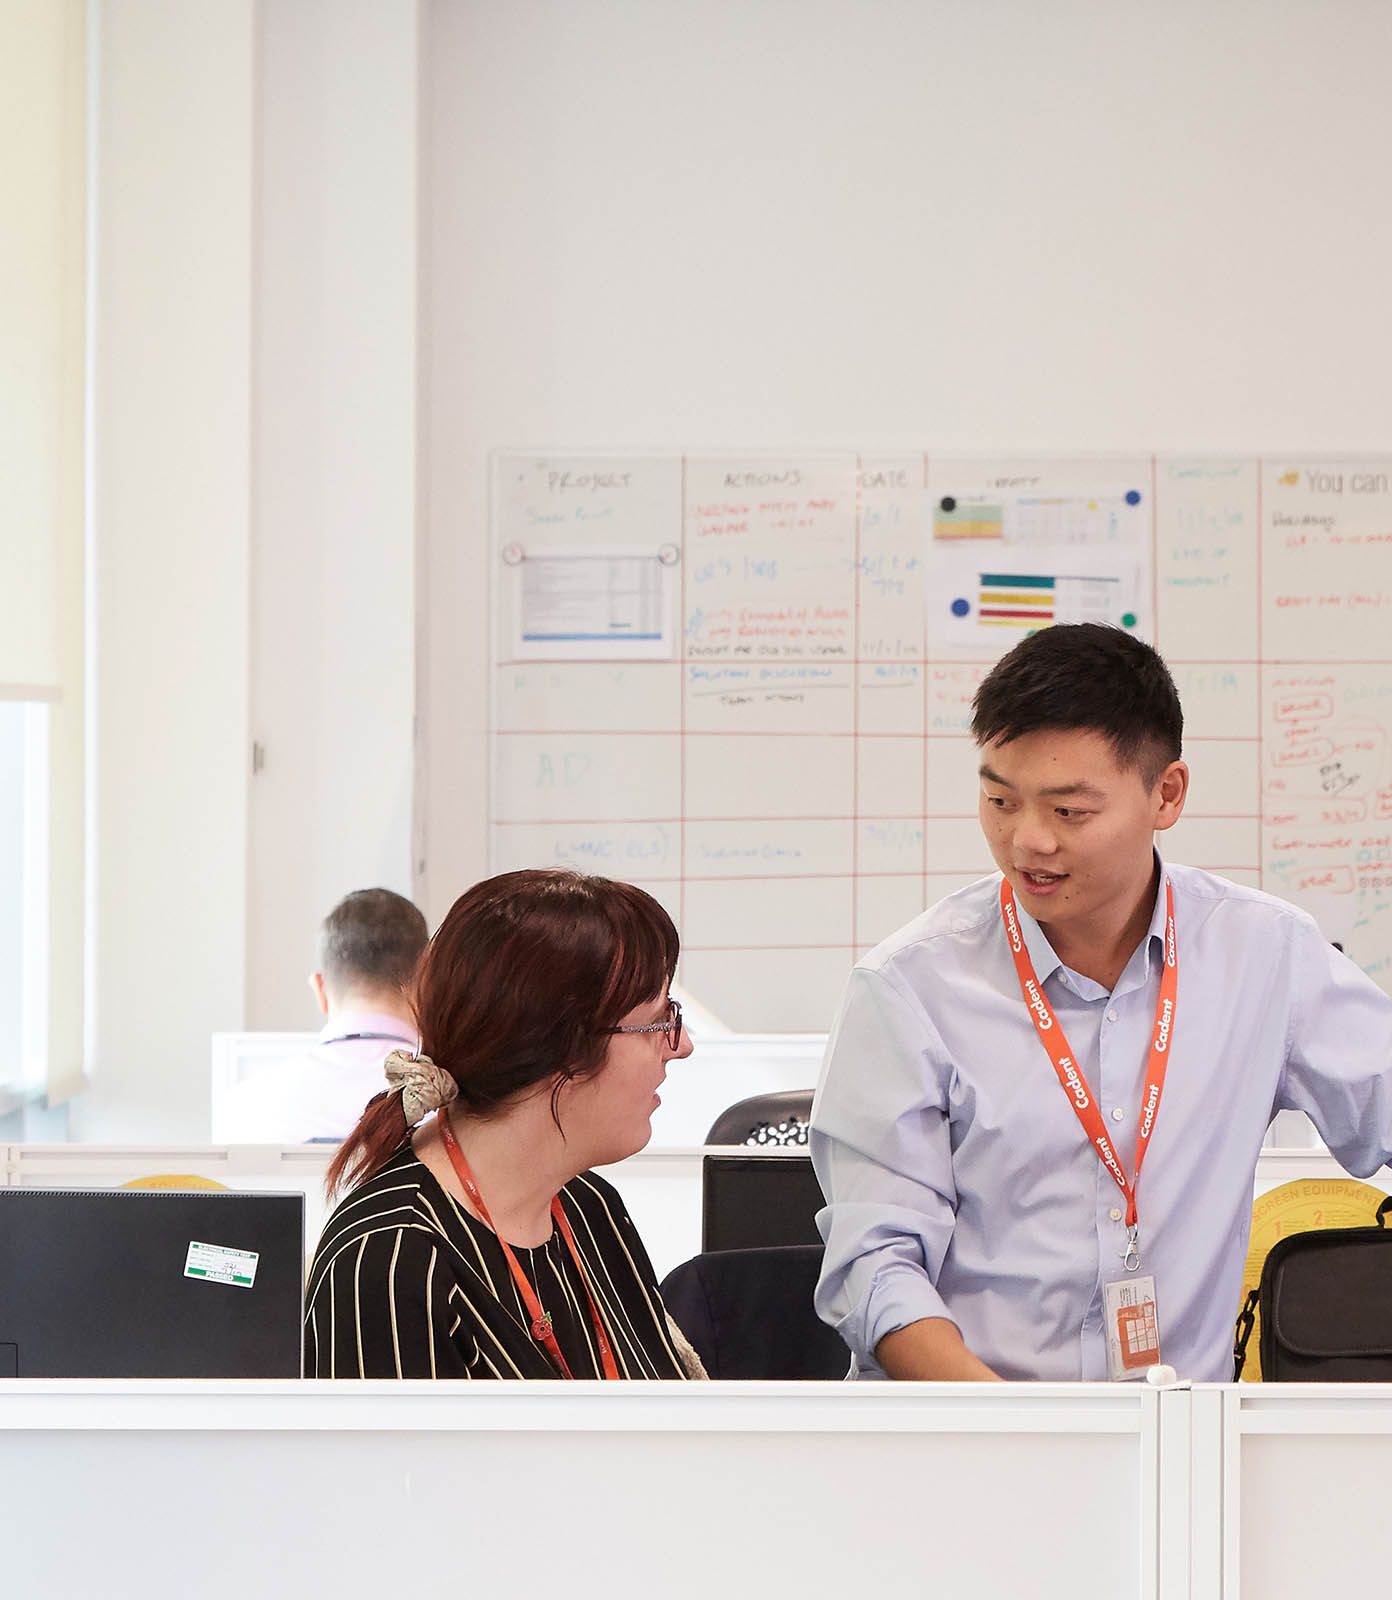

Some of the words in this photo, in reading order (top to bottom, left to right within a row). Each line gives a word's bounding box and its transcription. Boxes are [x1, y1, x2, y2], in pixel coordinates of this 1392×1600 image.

[1305, 470, 1343, 493] You
[1352, 477, 1387, 493] can
[1005, 903, 1021, 952] Cadent
[1167, 916, 1177, 967] Cadent
[1025, 980, 1052, 1029] Cadent
[1155, 998, 1173, 1052] Cadent
[1059, 1057, 1089, 1109] Cadent
[1140, 1084, 1159, 1138] Cadent
[1096, 1137, 1125, 1186] Cadent
